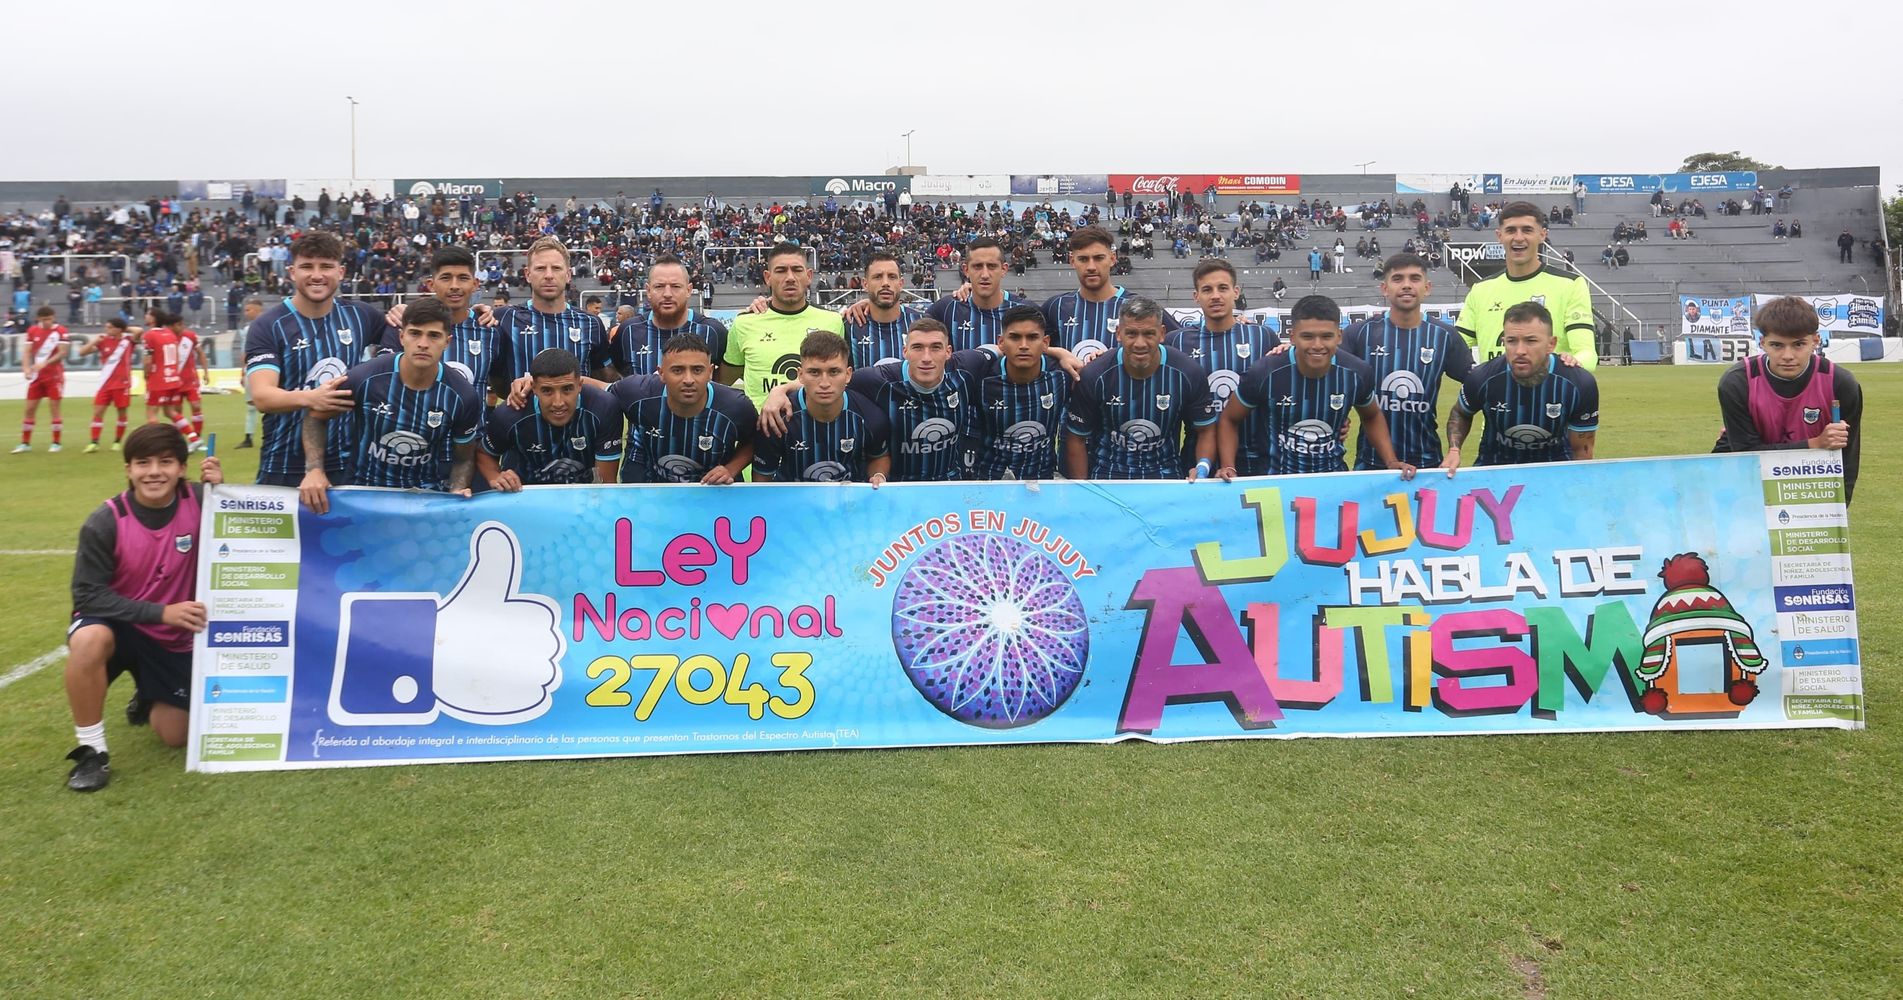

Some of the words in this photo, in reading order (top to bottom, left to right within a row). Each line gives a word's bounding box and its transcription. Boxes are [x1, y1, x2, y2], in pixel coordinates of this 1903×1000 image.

[852, 178, 896, 191] Macro
[1244, 176, 1286, 185] COMODIN
[1515, 178, 1538, 186] Jujuy
[1550, 176, 1572, 186] RM
[1600, 176, 1634, 187] EJESA
[1690, 174, 1728, 186] EJESA
[438, 182, 485, 194] Macro
[1690, 324, 1730, 334] DIAMANTE
[1688, 337, 1717, 361] LA
[1375, 394, 1431, 413] Macro
[901, 434, 959, 454] Macro
[993, 436, 1051, 453] Macro
[1110, 430, 1165, 452] Macro
[1278, 433, 1336, 454] Macro
[1496, 431, 1560, 450] Macro
[368, 441, 432, 467] Macro
[1773, 464, 1842, 476] SONRISAS
[1783, 481, 1841, 490] MINISTERIO
[1784, 492, 1798, 500] DE
[1801, 490, 1835, 498] SALUD
[228, 517, 284, 525] MINISTERIO
[228, 526, 242, 534] DE
[244, 526, 278, 534] SALUD
[1193, 484, 1524, 583] JUJUY
[868, 512, 962, 588] JUNTOS
[968, 509, 1007, 532] EN
[1011, 517, 1098, 580] JUJUY
[1347, 552, 1547, 606] HABLA
[1554, 545, 1648, 598] DE
[1797, 615, 1850, 624] MINISTERIO
[1798, 626, 1814, 634] DE
[1814, 624, 1846, 634] SALUD
[222, 652, 278, 660] MINISTERIO
[221, 662, 235, 670] DE
[238, 662, 271, 670] SALUD
[585, 652, 815, 722] 27043
[360, 736, 370, 746] al
[372, 736, 416, 748] abordaje
[418, 736, 454, 748] integral
[466, 734, 544, 747] interdisciplinario
[546, 736, 559, 744] de
[560, 735, 576, 744] las
[578, 736, 620, 746] personas
[622, 737, 641, 747] que
[643, 736, 689, 745] presentan
[692, 732, 740, 742] Trastornos
[742, 731, 757, 740] del
[760, 730, 799, 741] Espectro
[836, 728, 860, 740] (TEA)
